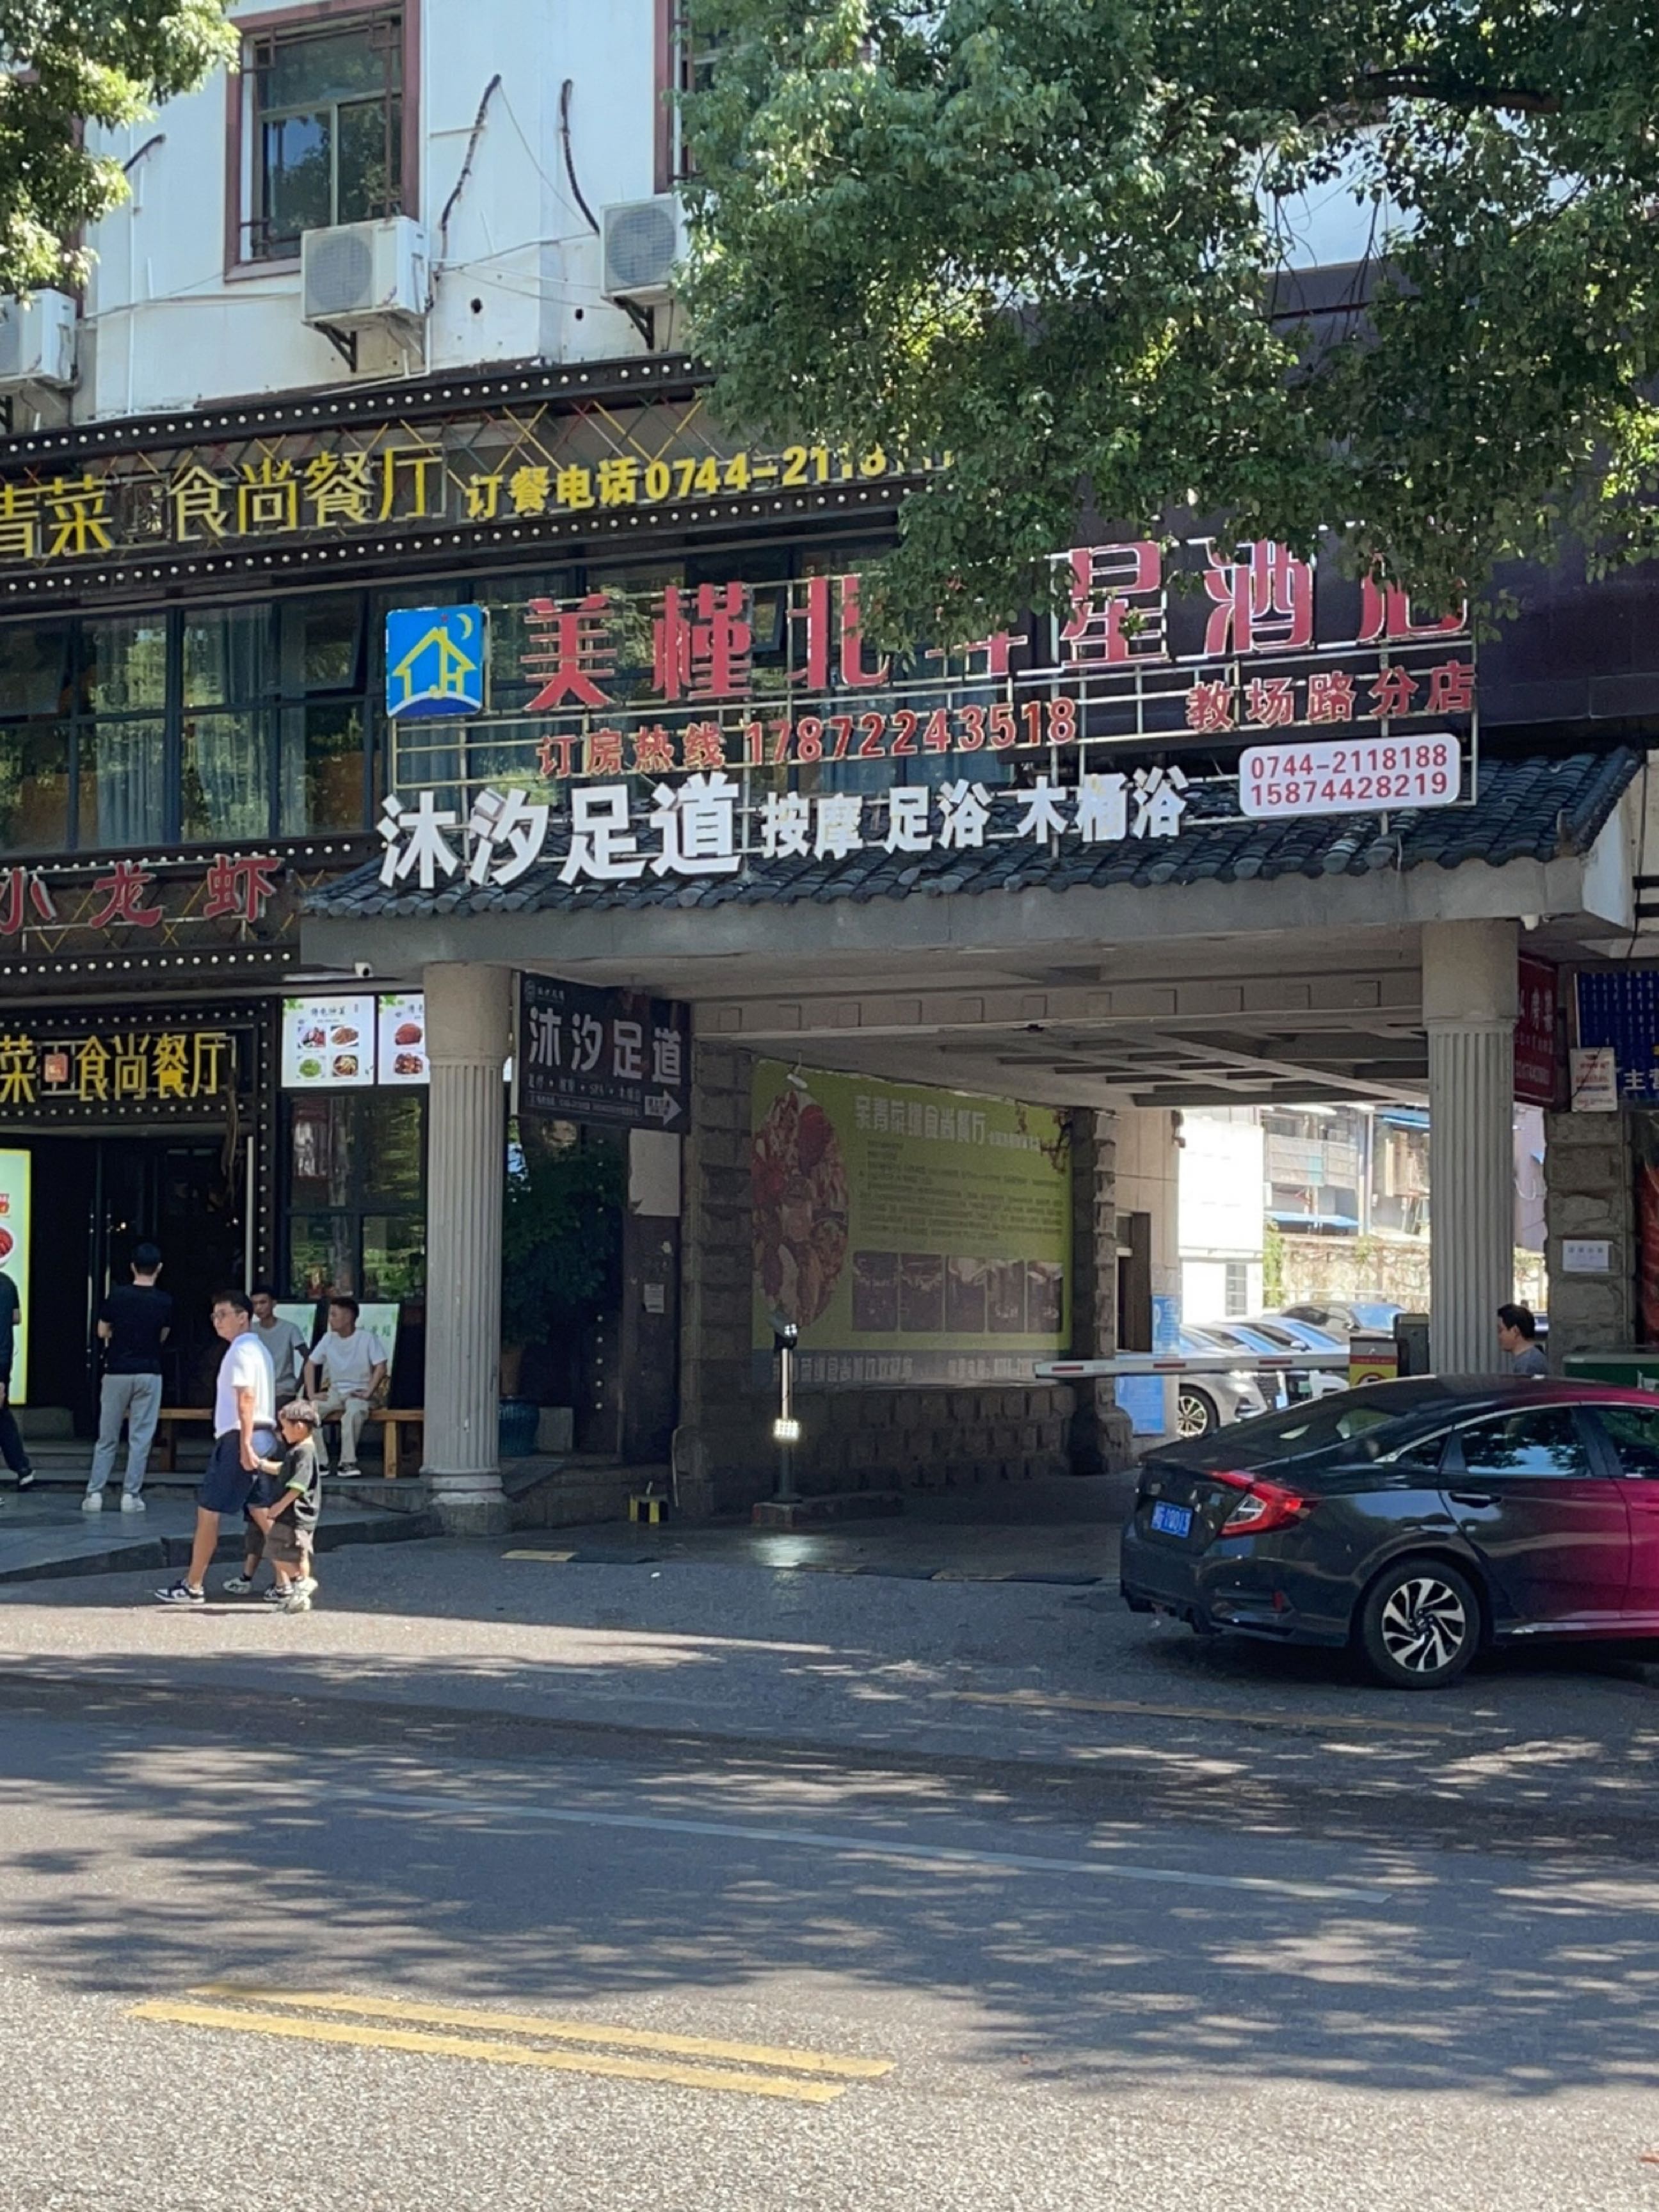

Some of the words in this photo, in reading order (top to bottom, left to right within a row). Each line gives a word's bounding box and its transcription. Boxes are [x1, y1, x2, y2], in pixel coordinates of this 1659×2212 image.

[168, 442, 443, 543] 食尚餐厅
[520, 538, 1468, 711] 美槿北星酒
[1186, 660, 1476, 732] 教场路分店
[536, 721, 726, 779] 订房热线
[744, 696, 1078, 766] 17872243518
[1251, 743, 1448, 780] 0744-2118188
[376, 772, 742, 890] 沐汐足道
[760, 792, 863, 860] 按摩
[887, 782, 992, 853] 足浴
[1017, 766, 1188, 846] 木桶浴
[1251, 773, 1448, 808] 15874428219
[0, 855, 285, 935] 小龙虾
[76, 1032, 227, 1102] 食尚餐厅
[529, 1006, 682, 1085] 沐汐足道
